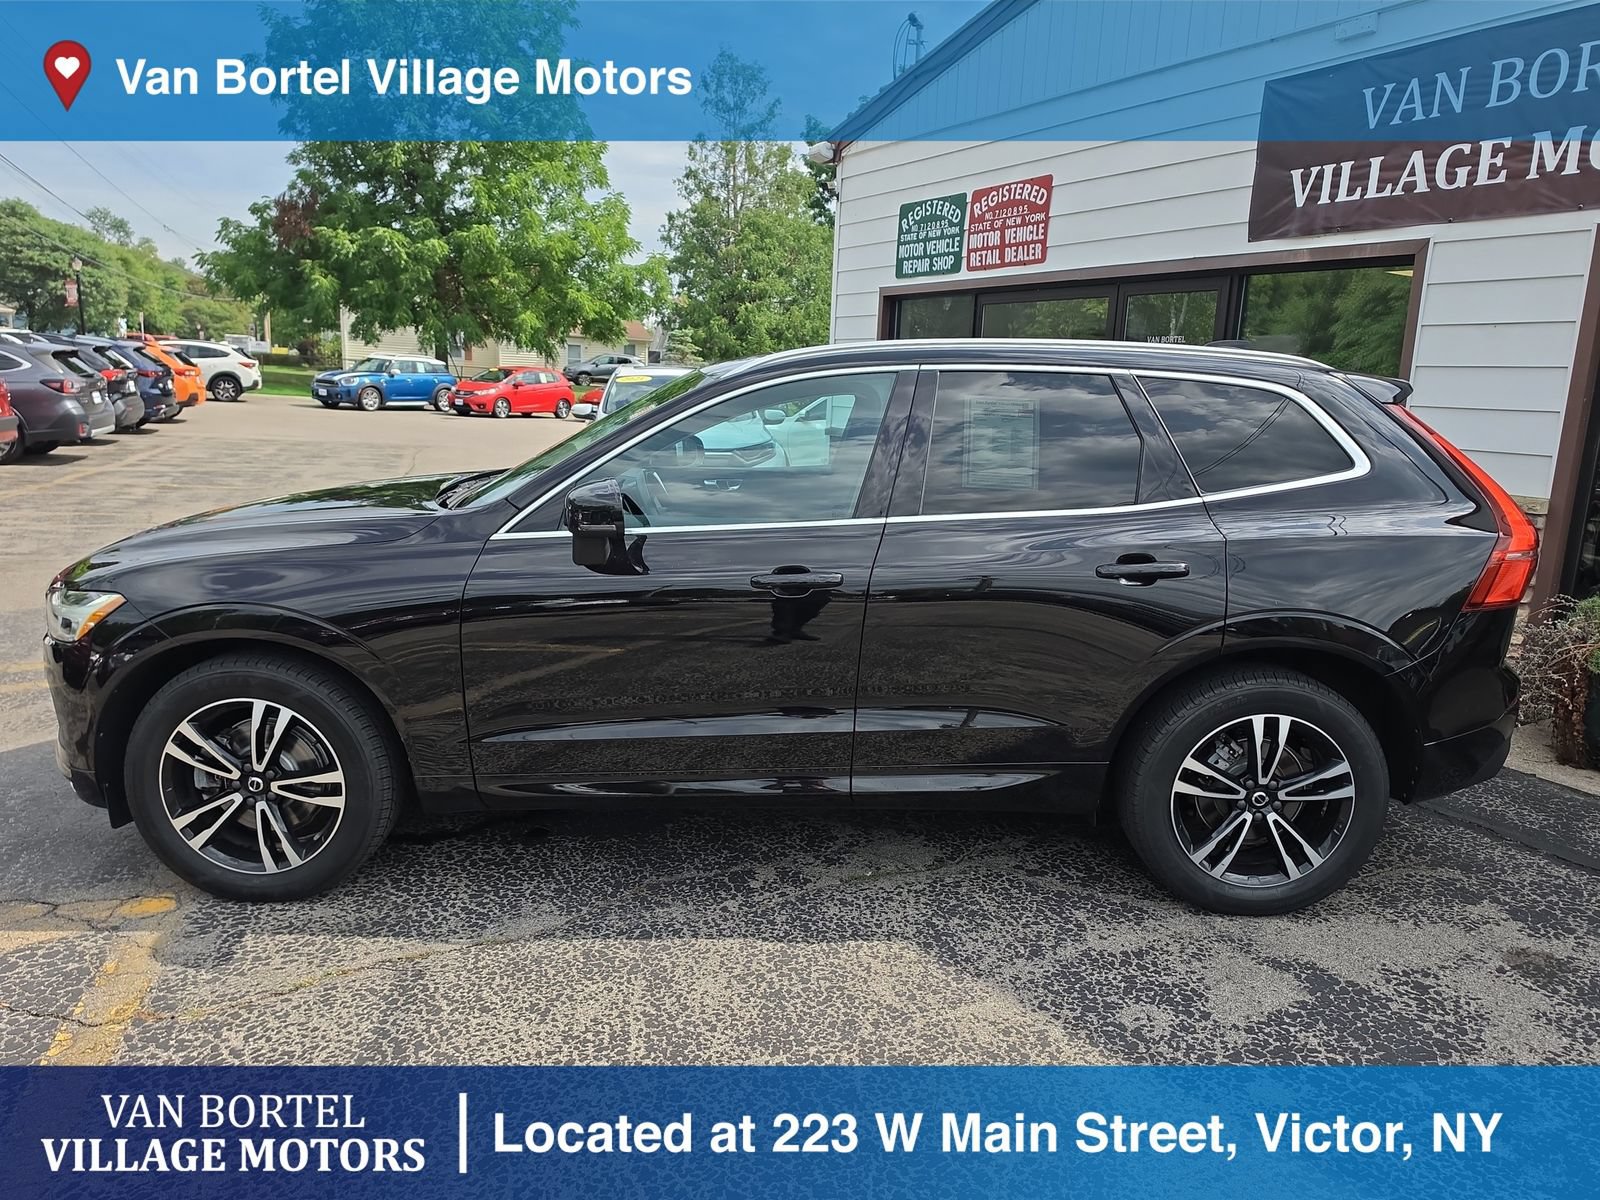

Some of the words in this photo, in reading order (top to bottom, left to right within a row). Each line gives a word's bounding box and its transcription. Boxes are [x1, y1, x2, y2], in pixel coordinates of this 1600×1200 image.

[1363, 66, 1472, 130] VAN
[1290, 136, 1512, 208] VILLAGE
[973, 184, 1047, 218] REGISTERED
[995, 205, 1029, 218] 7120895
[901, 200, 961, 232] REGISTERED
[920, 220, 949, 231] 7120895
[970, 221, 991, 232] STATE
[994, 220, 1003, 228] OF
[1006, 216, 1022, 226] NEW
[1025, 212, 1046, 223] YORK
[900, 233, 918, 242] STATE
[928, 230, 941, 238] NEW
[943, 226, 960, 235] YORK
[969, 231, 1000, 249] MOTOR
[1005, 223, 1045, 244] VEHICLE
[899, 242, 924, 258] MOTOR
[926, 237, 960, 255] VEHICLE
[970, 250, 1001, 267] RETAIL
[1005, 243, 1042, 263] DEALER
[903, 259, 930, 274] REPAIR
[932, 255, 955, 271] SHOP
